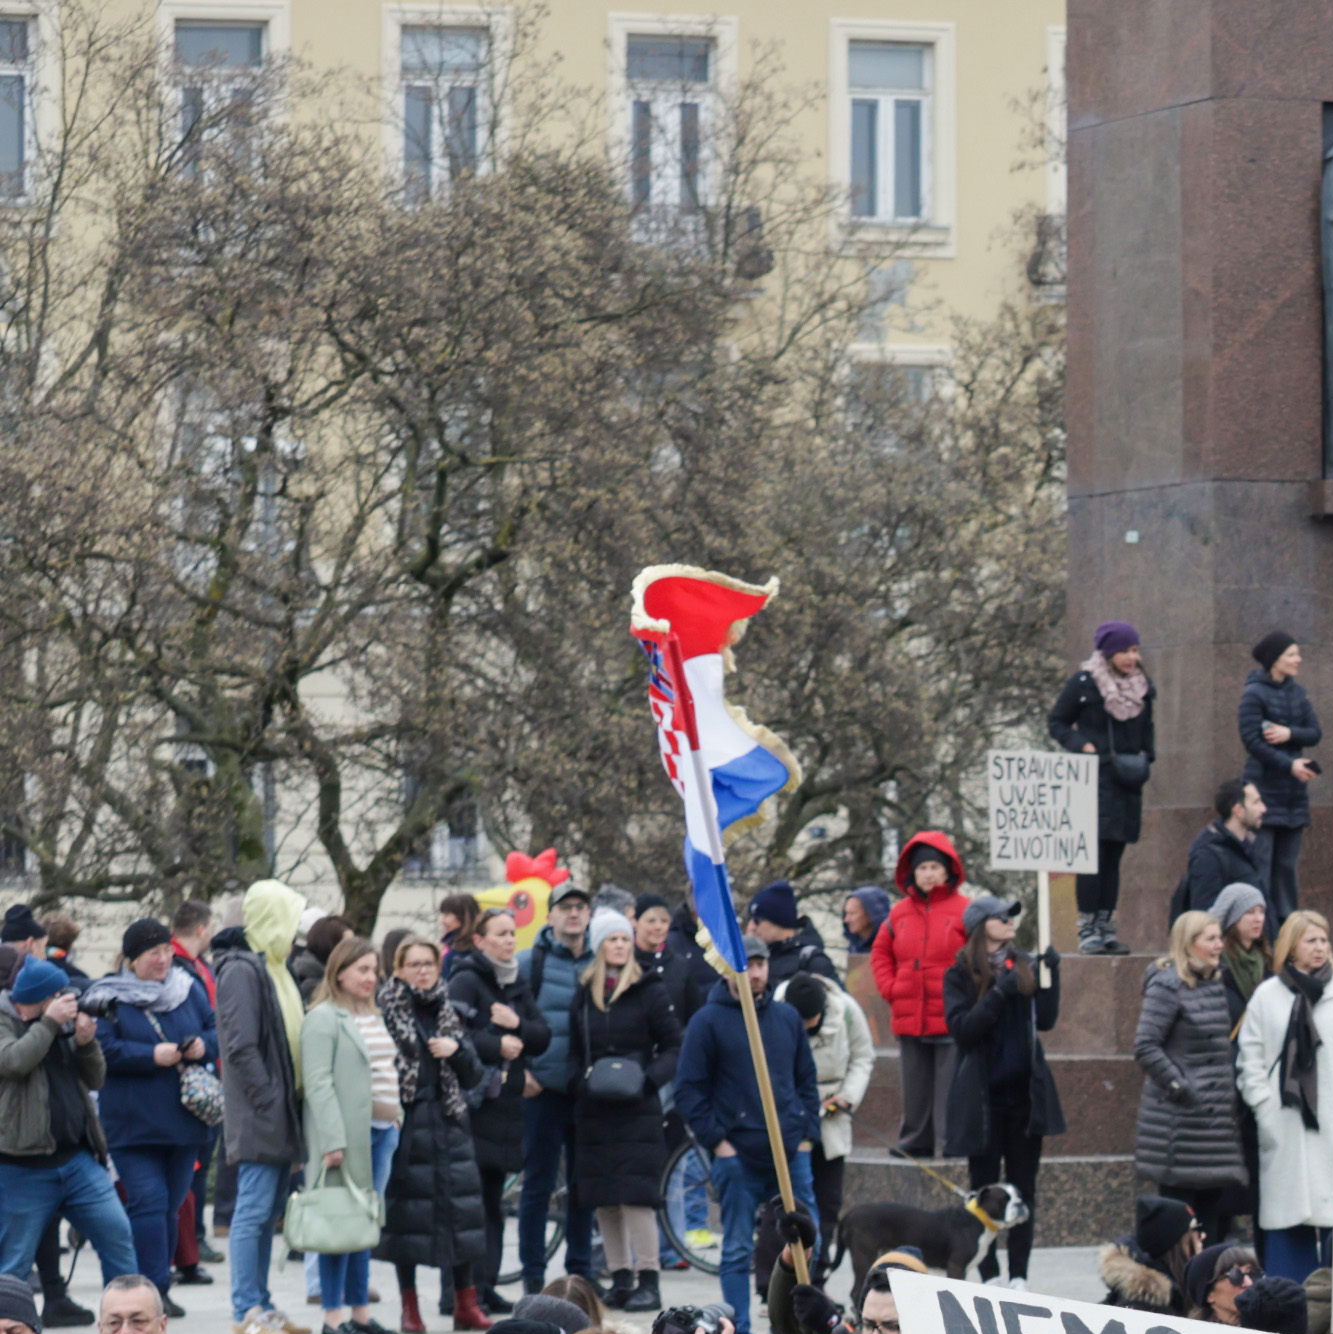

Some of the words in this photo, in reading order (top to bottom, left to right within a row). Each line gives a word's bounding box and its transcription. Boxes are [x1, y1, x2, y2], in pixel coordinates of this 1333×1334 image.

[999, 783, 1071, 807] UVJETI
[996, 807, 1072, 832] DRŽANJA
[996, 831, 1089, 867] ŽIVOTINJA
